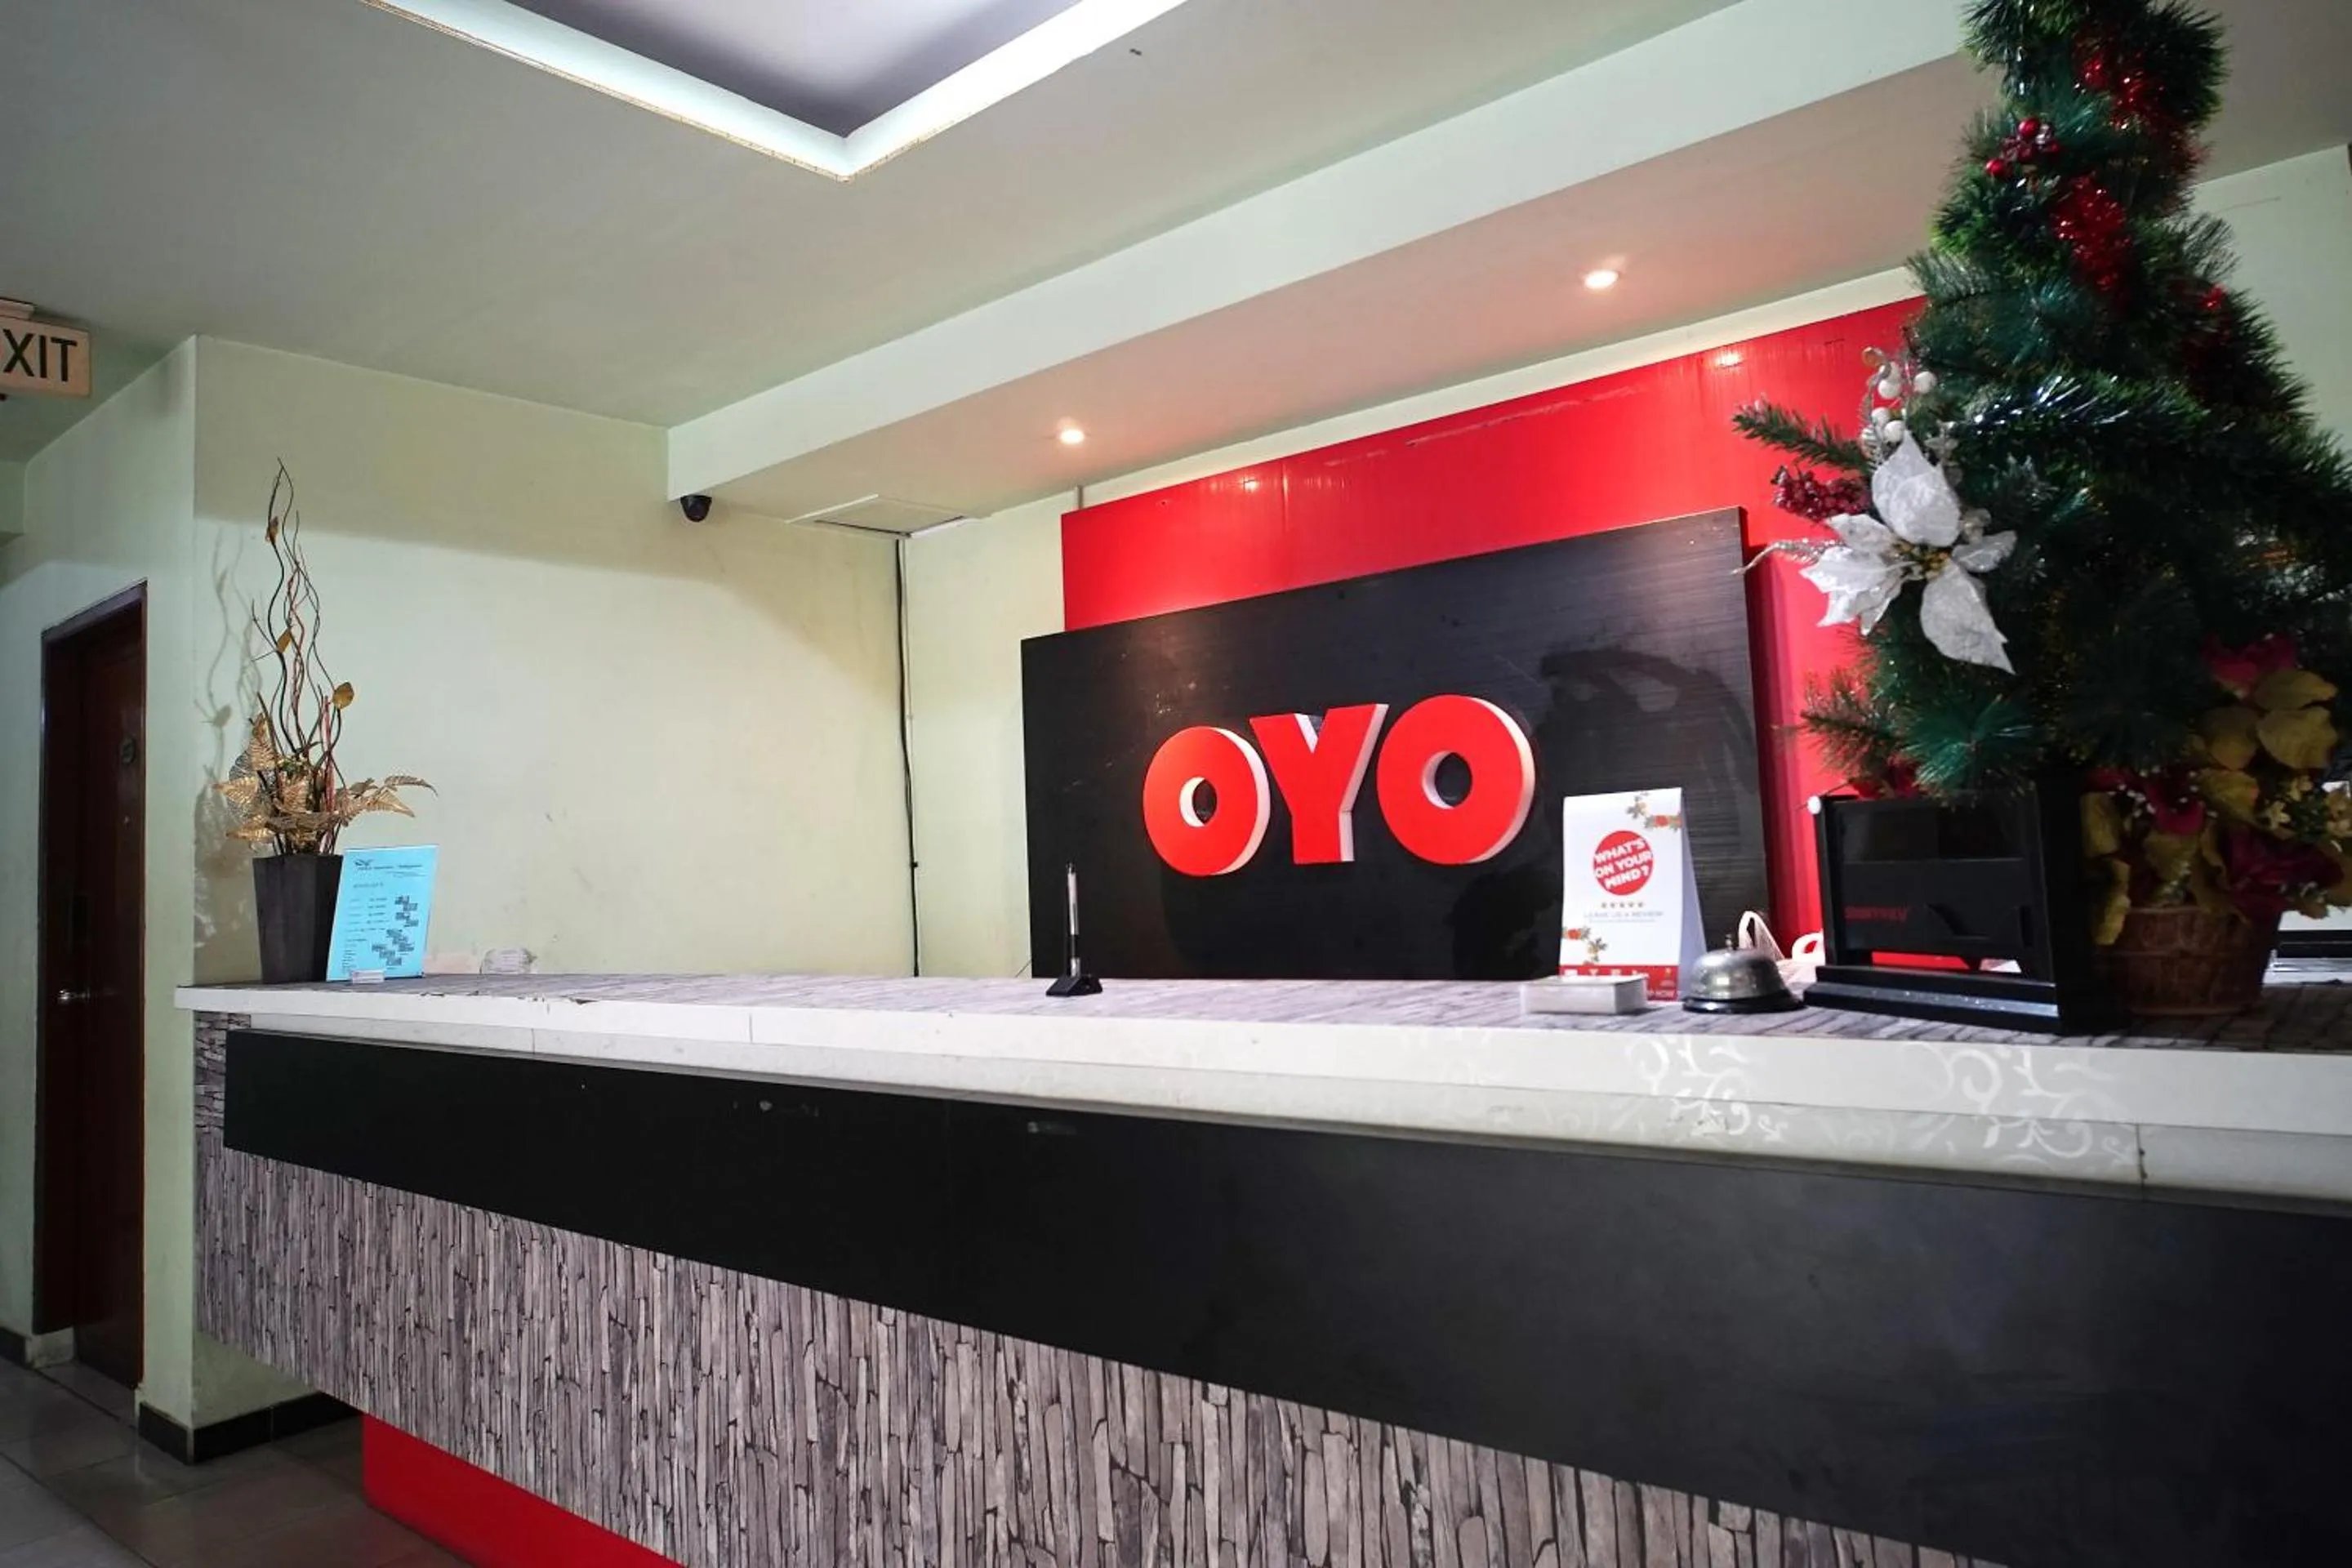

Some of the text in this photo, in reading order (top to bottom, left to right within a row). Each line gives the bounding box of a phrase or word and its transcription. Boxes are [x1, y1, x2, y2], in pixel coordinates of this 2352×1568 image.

[2, 328, 78, 383] XIT
[1143, 693, 1535, 876] OYO
[1595, 838, 1646, 862] WHAT'S
[1596, 851, 1651, 878] ON YOUR
